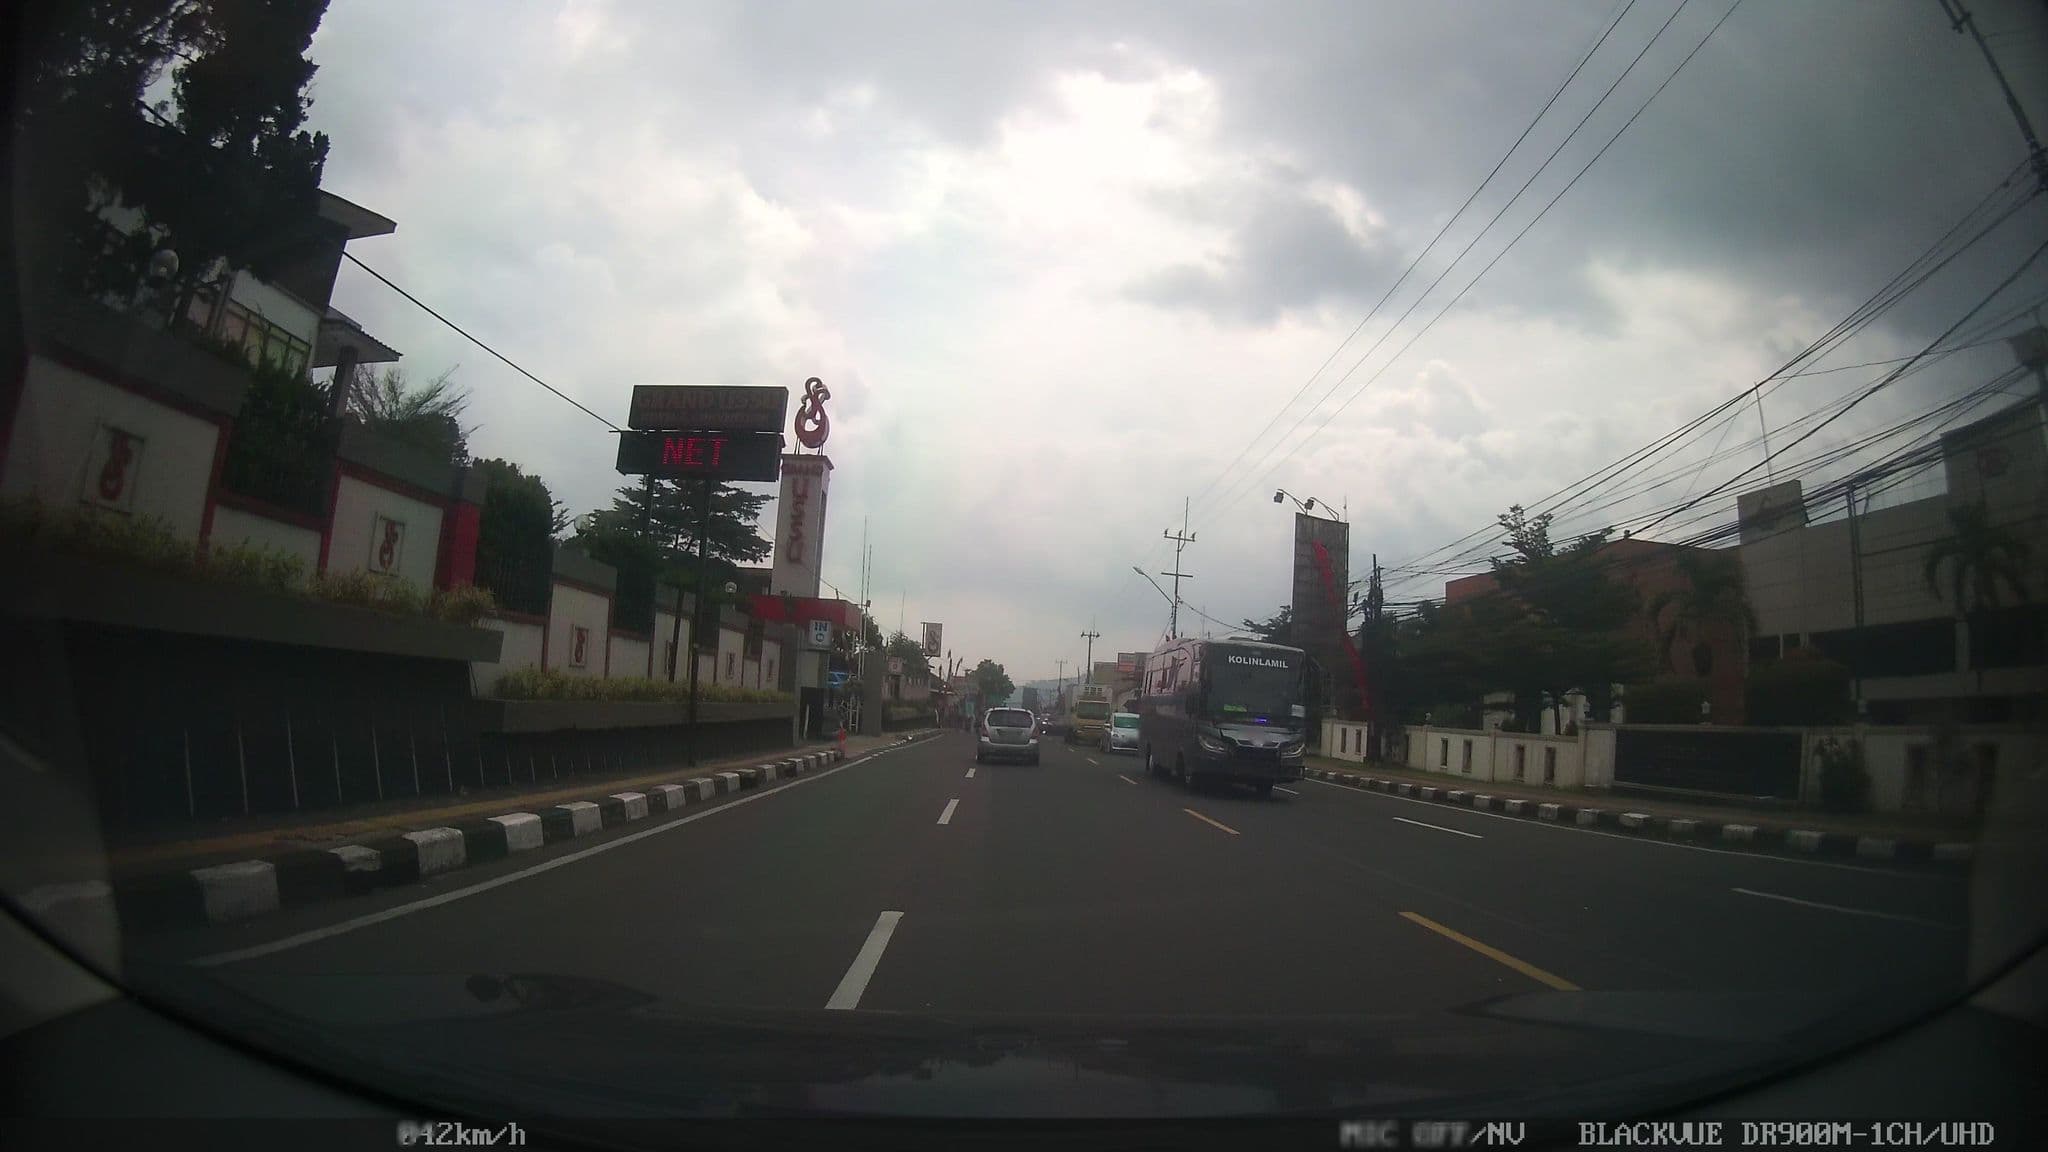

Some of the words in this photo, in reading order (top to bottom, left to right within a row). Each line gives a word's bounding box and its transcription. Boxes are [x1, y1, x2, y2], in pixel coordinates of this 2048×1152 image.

[662, 437, 728, 465] NET
[815, 621, 827, 632] IN
[1228, 655, 1289, 669] KOLINLAMIL
